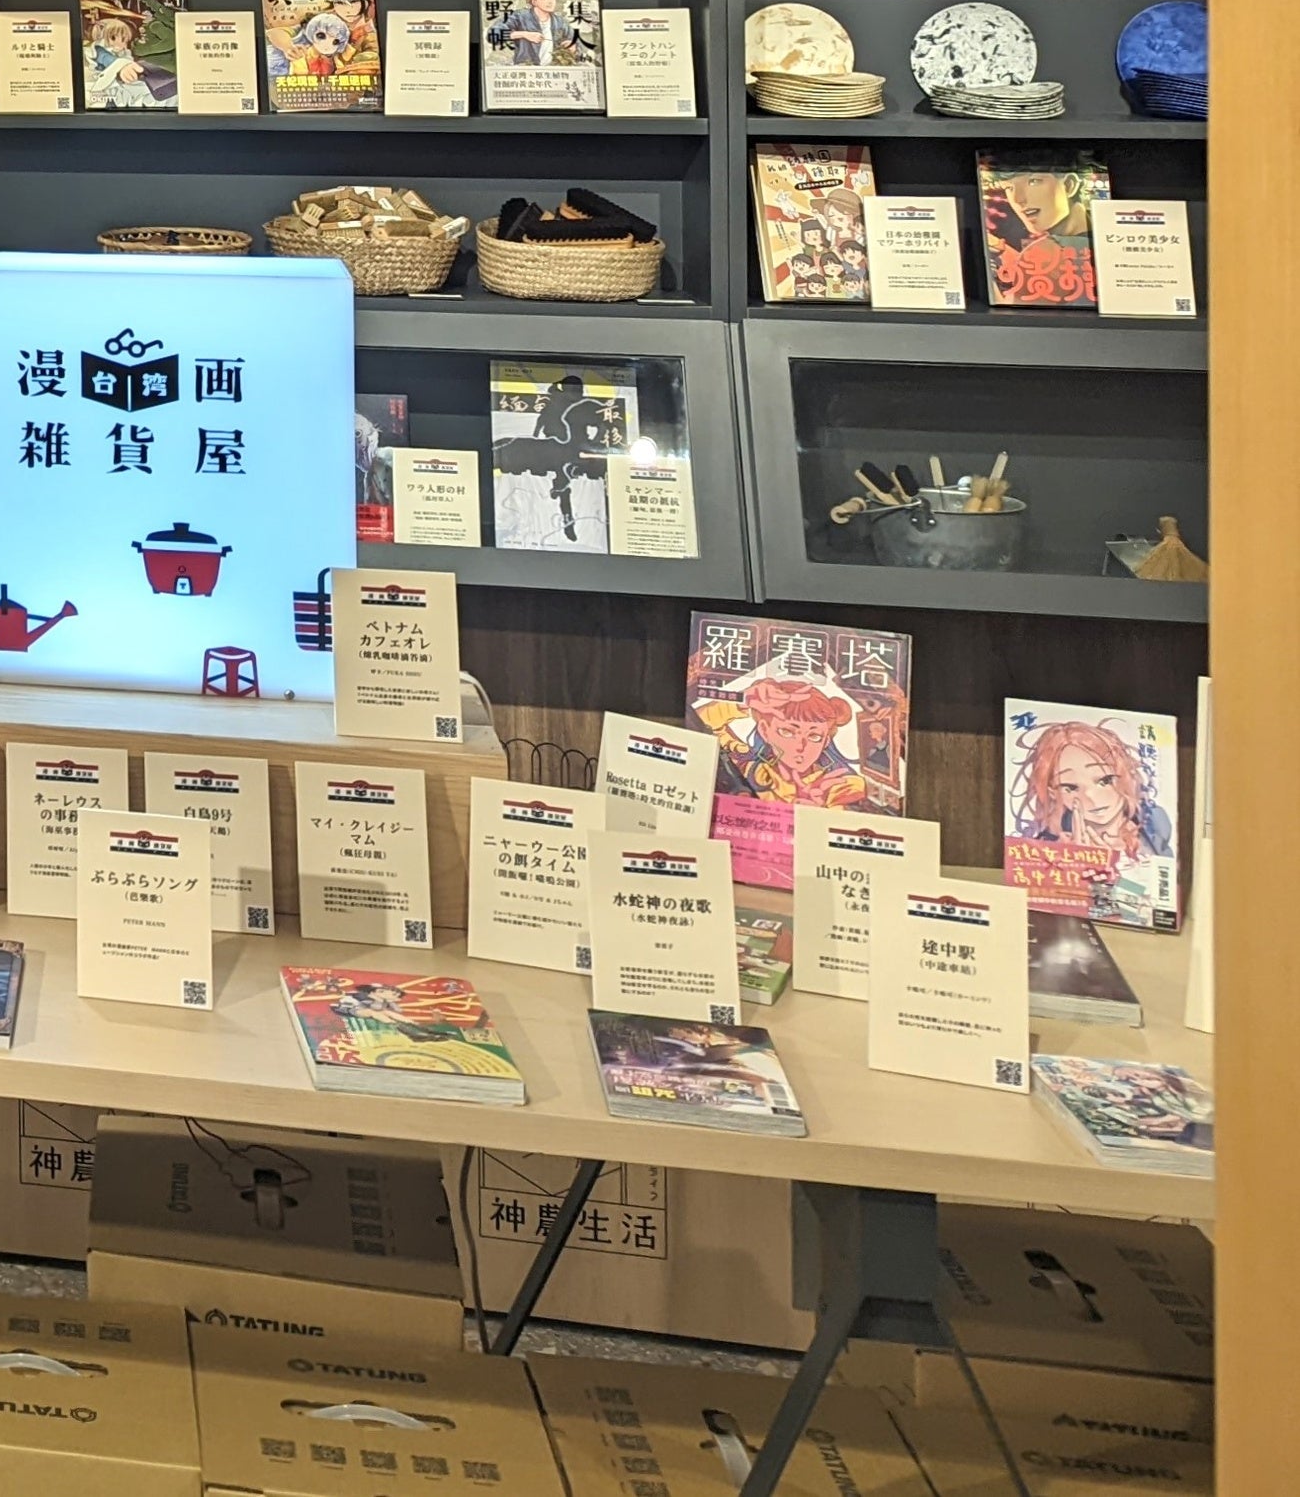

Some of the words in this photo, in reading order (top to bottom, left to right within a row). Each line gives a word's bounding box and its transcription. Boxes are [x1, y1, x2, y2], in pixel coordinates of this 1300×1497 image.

[18, 422, 247, 476] 雑貨屋
[367, 620, 424, 635] ベトナム
[360, 634, 432, 650] カフェオレ
[606, 771, 647, 791] Rosetta
[653, 783, 699, 803] ロゼット
[34, 792, 102, 809] ネーレウス
[310, 817, 414, 834] マイ・クレイジー
[350, 833, 375, 846] マム
[498, 853, 576, 874] の餌タイム
[91, 869, 199, 892] ぶらぶらソング
[613, 891, 713, 914] 水蛇神の夜歌
[921, 938, 976, 961] 途中駅
[314, 1360, 427, 1385] TATUNG
